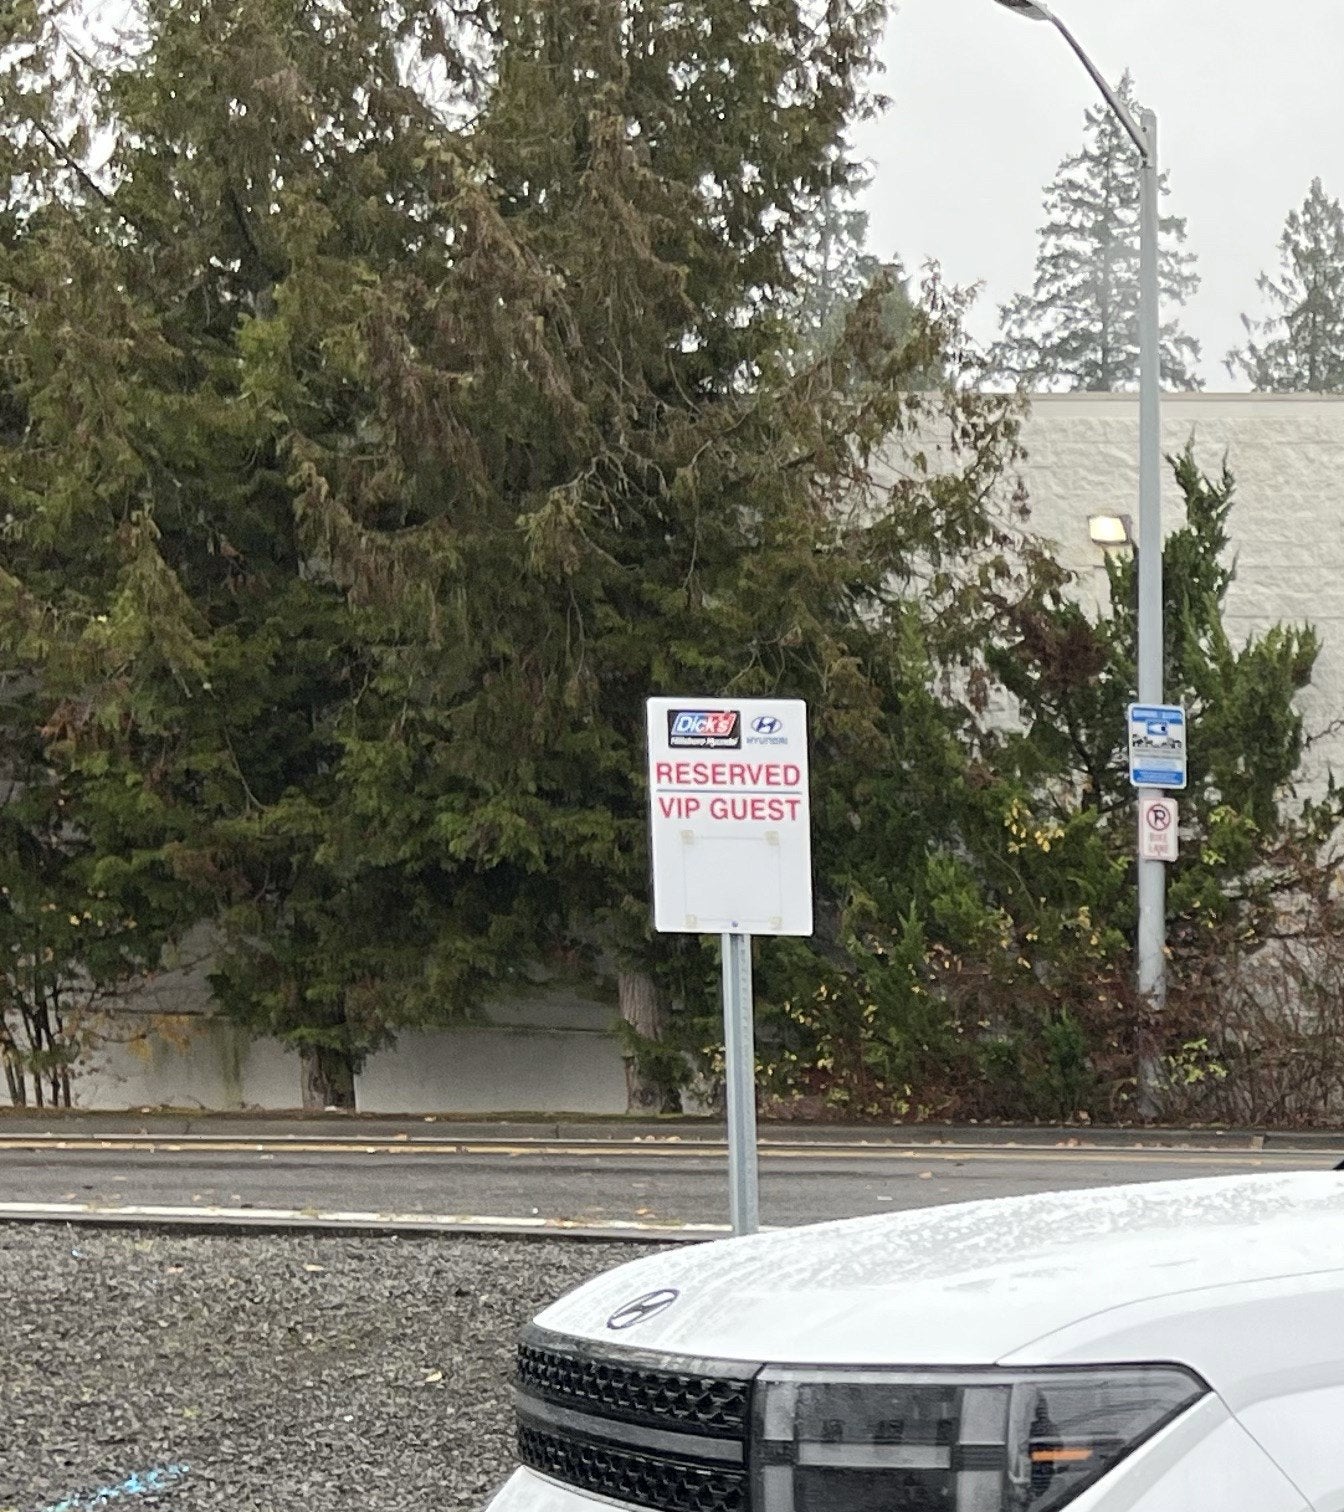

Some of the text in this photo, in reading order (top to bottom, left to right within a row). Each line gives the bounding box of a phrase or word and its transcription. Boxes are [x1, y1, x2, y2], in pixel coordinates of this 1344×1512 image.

[656, 762, 801, 787] RESERVED
[659, 797, 801, 821] VIP GUEST
